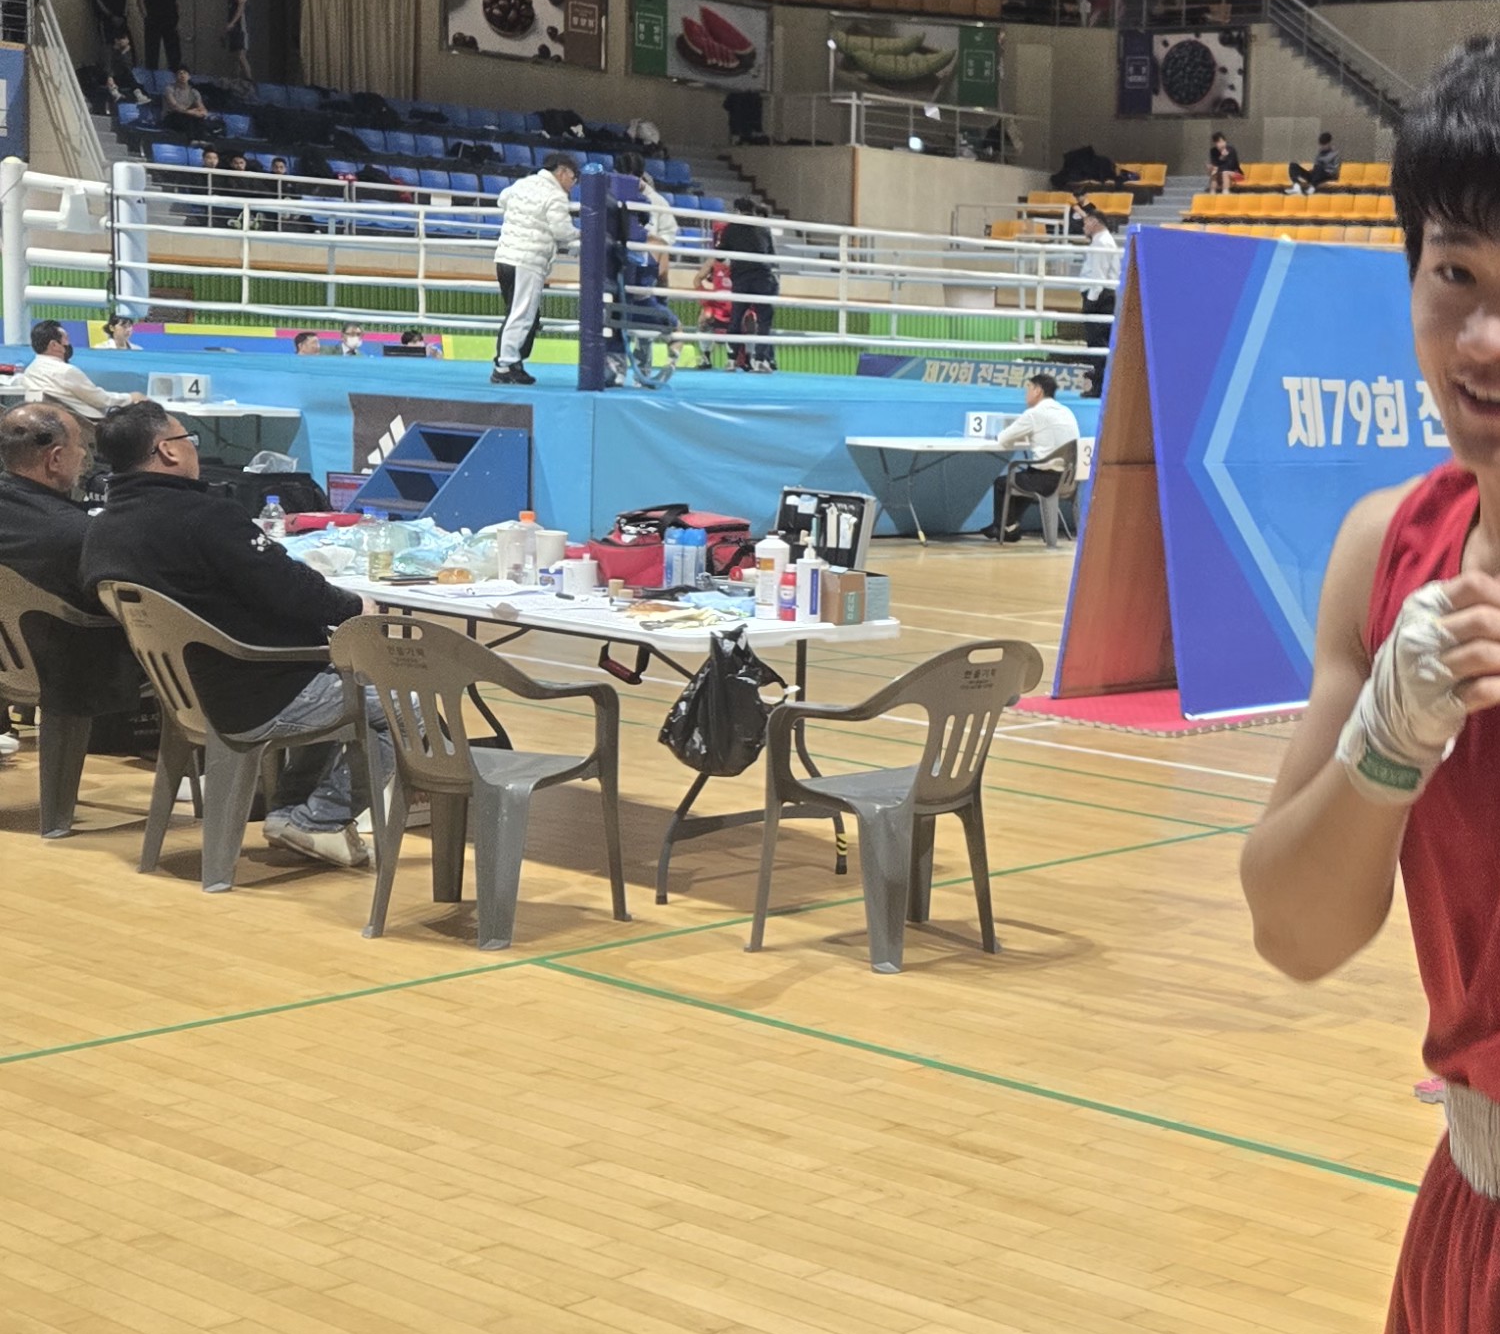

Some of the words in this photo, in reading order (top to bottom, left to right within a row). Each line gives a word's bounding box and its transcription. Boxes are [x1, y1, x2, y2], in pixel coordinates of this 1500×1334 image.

[923, 359, 974, 385] 제79회
[188, 379, 201, 397] 4
[1282, 375, 1409, 448] 제79회
[973, 416, 983, 433] 3
[1083, 444, 1093, 467] 3
